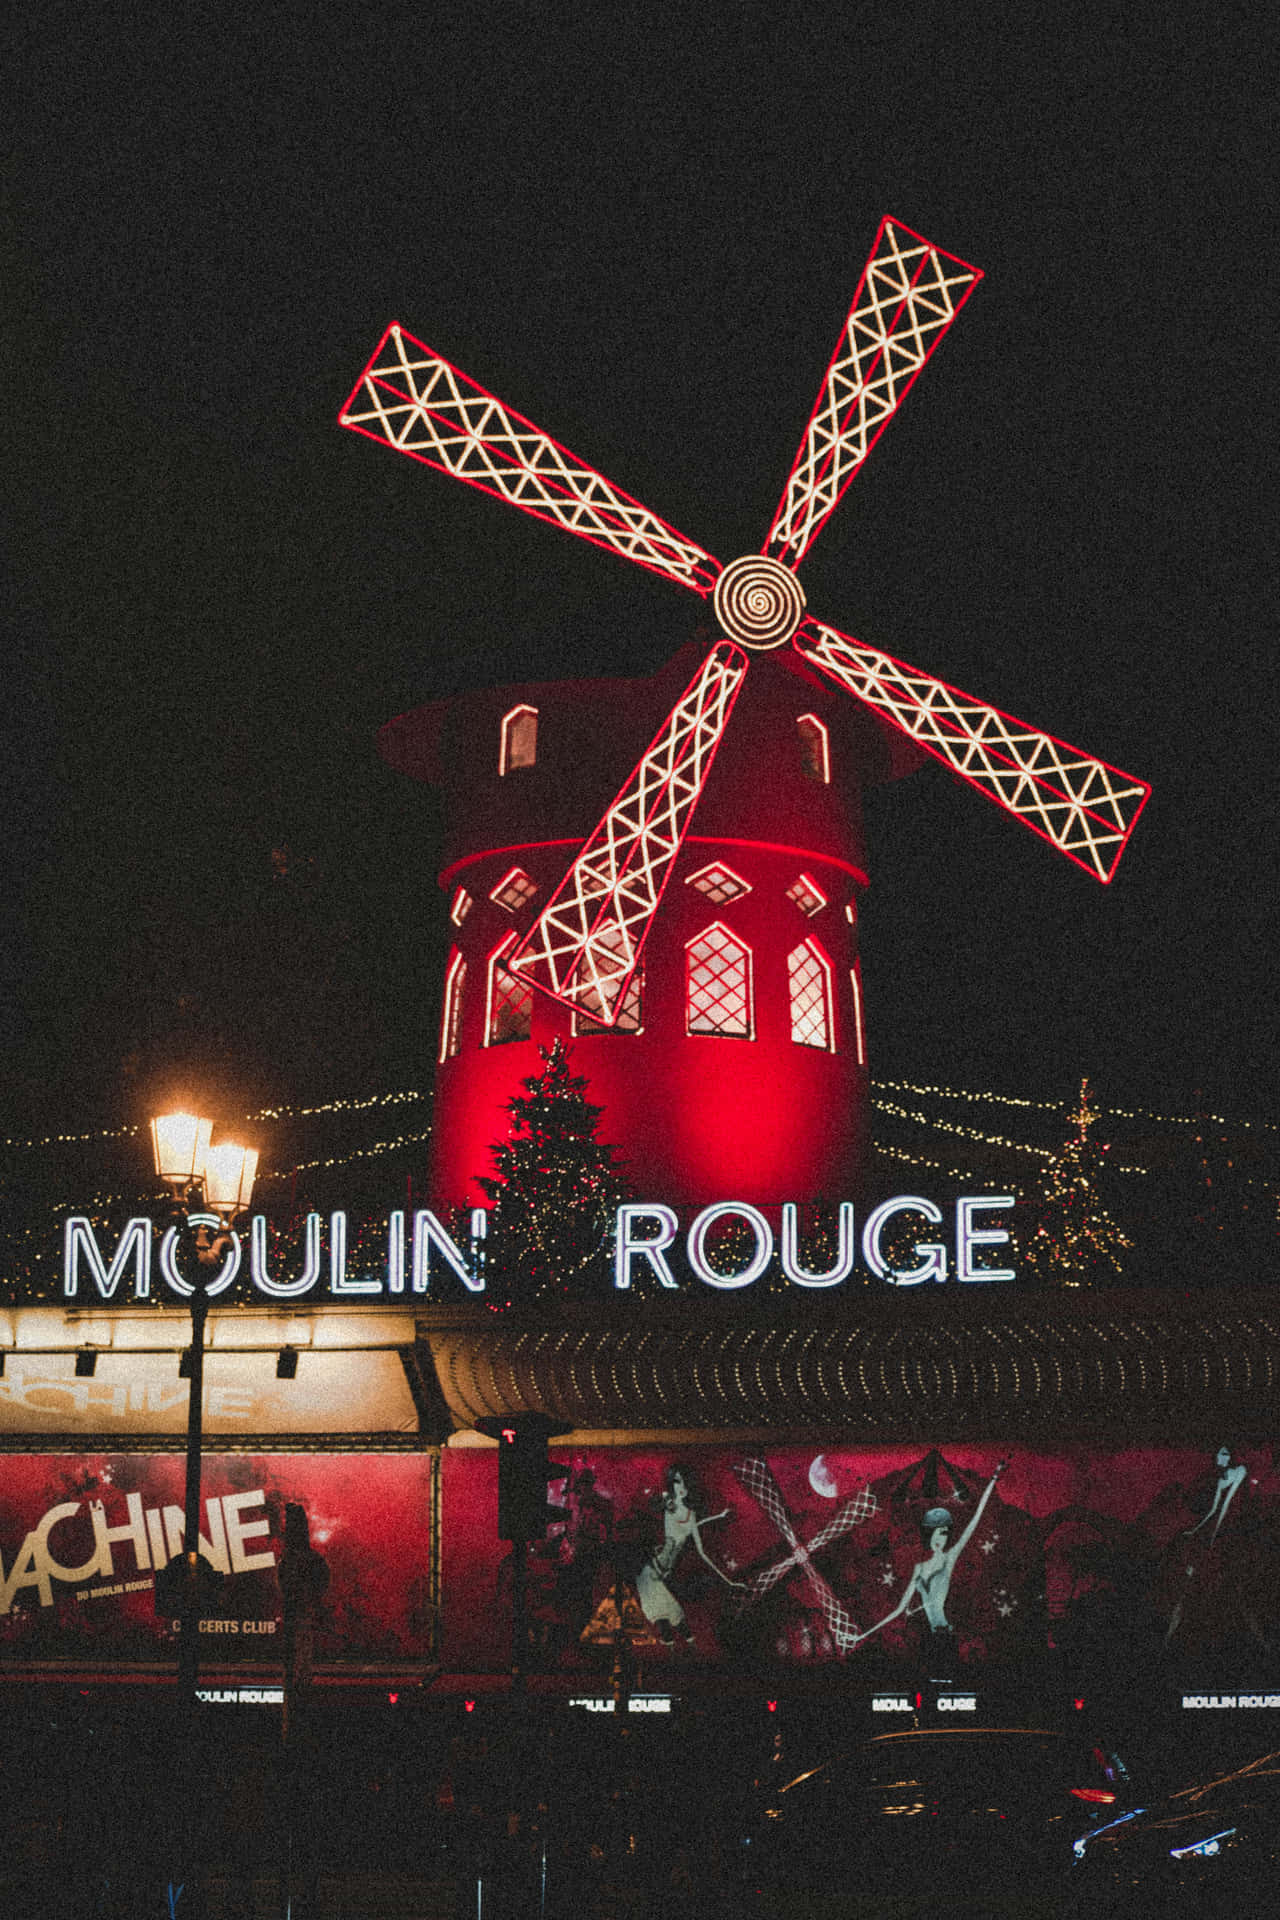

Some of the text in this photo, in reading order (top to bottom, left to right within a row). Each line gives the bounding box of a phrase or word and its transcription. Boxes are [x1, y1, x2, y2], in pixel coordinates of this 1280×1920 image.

[64, 1195, 1017, 1298] MOULIN ROUGE
[0, 1489, 276, 1615] ACHINE
[76, 1579, 154, 1601] DU MOULIN ROUGE
[172, 1620, 276, 1634] CCERTS CLUB
[195, 1690, 238, 1703] OULIN
[1182, 1695, 1237, 1708] MOULIN
[872, 1697, 977, 1712] MOUL OUGE
